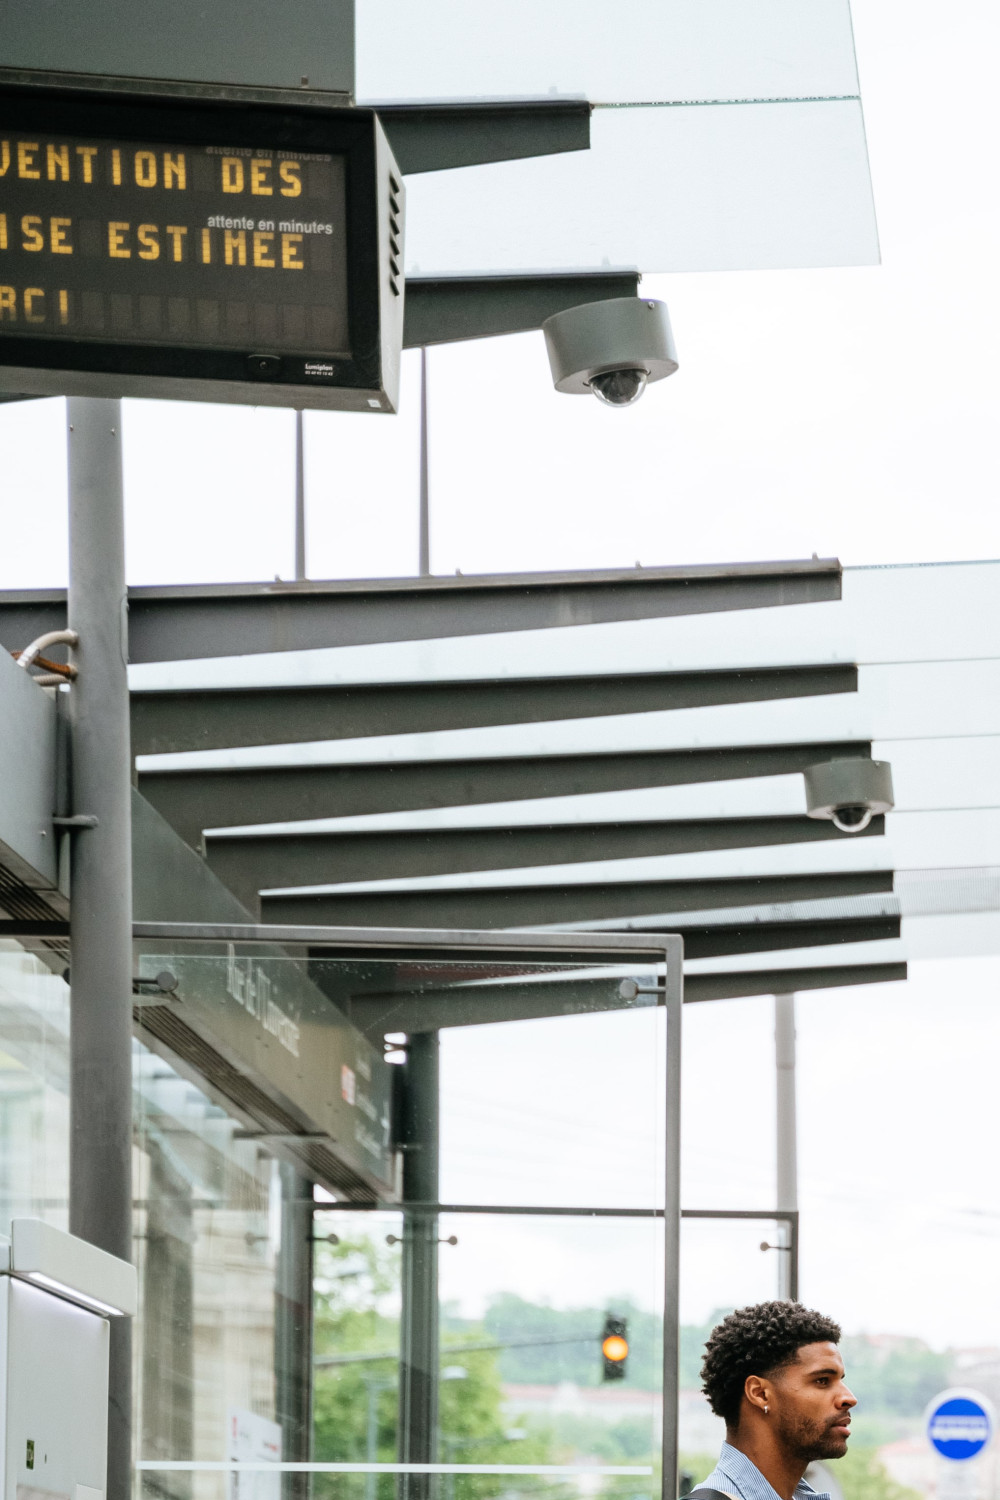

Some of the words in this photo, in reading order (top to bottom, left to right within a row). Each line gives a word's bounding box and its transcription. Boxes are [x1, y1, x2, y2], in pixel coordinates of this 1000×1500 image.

[222, 157, 302, 197] DES
[108, 221, 304, 269] ESTIMEE
[207, 216, 254, 230] attente
[258, 219, 275, 231] en
[279, 220, 333, 235] minutes
